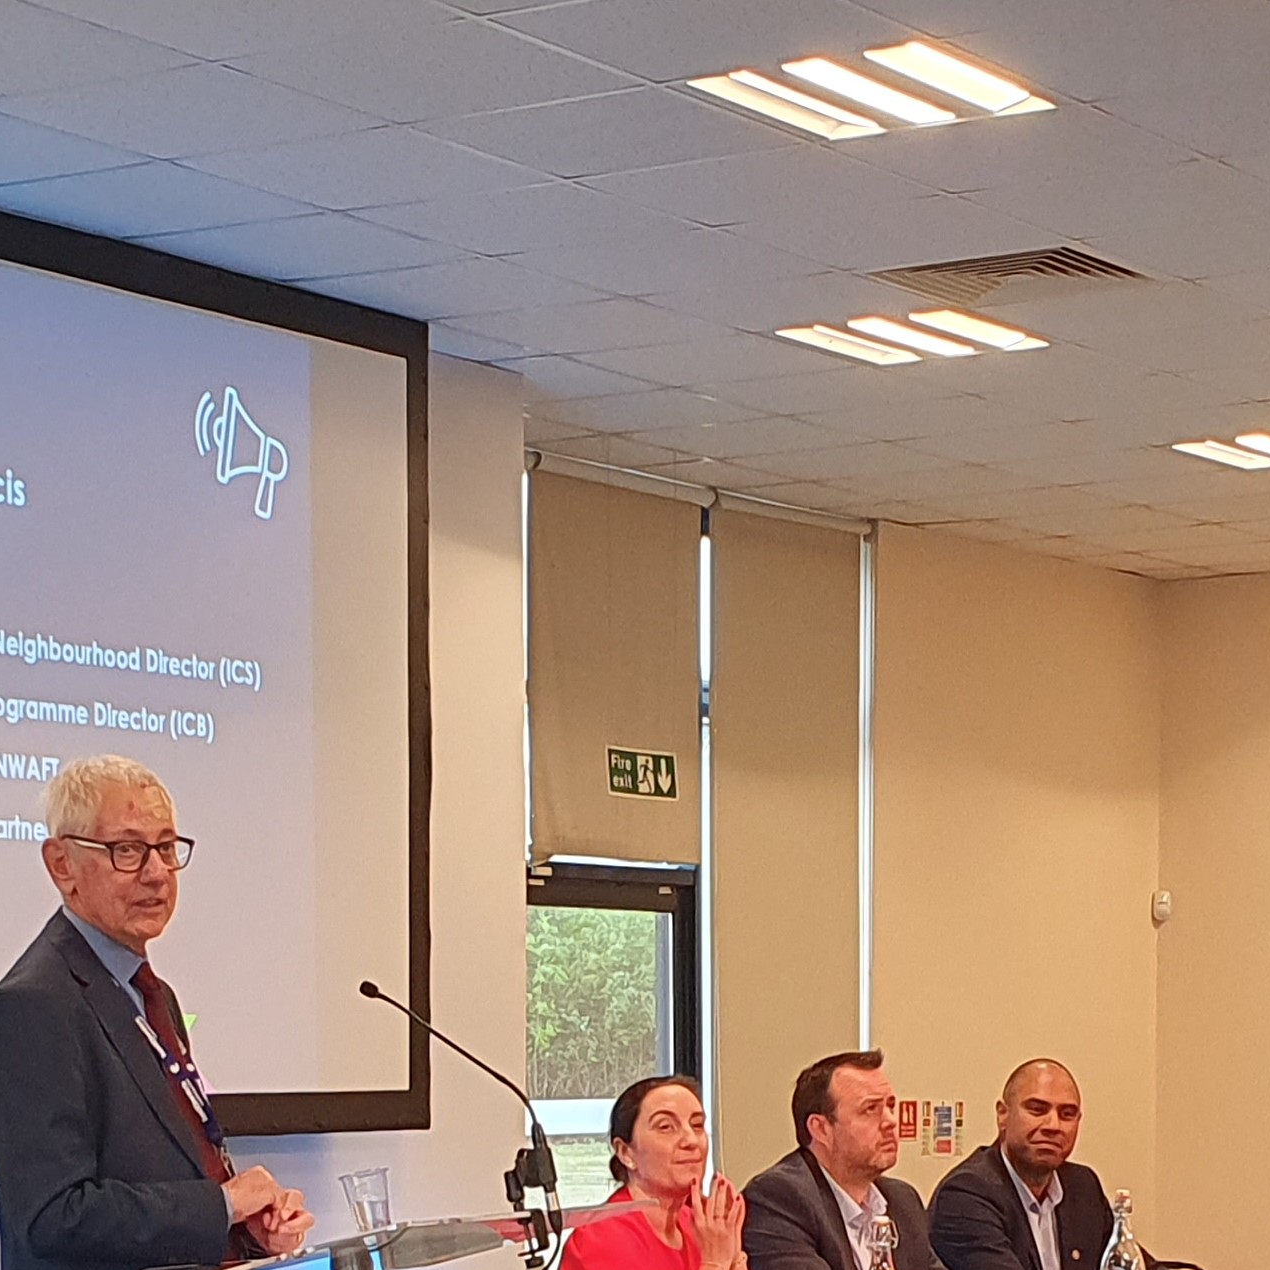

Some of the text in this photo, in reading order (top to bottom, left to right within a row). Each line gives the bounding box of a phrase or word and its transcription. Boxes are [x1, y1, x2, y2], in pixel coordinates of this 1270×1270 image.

[146, 647, 216, 682] Director
[219, 656, 262, 692] (ICS)
[94, 701, 166, 735] Director
[169, 709, 215, 745] (ICB)
[611, 753, 632, 771] Fire
[612, 773, 632, 789] exit
